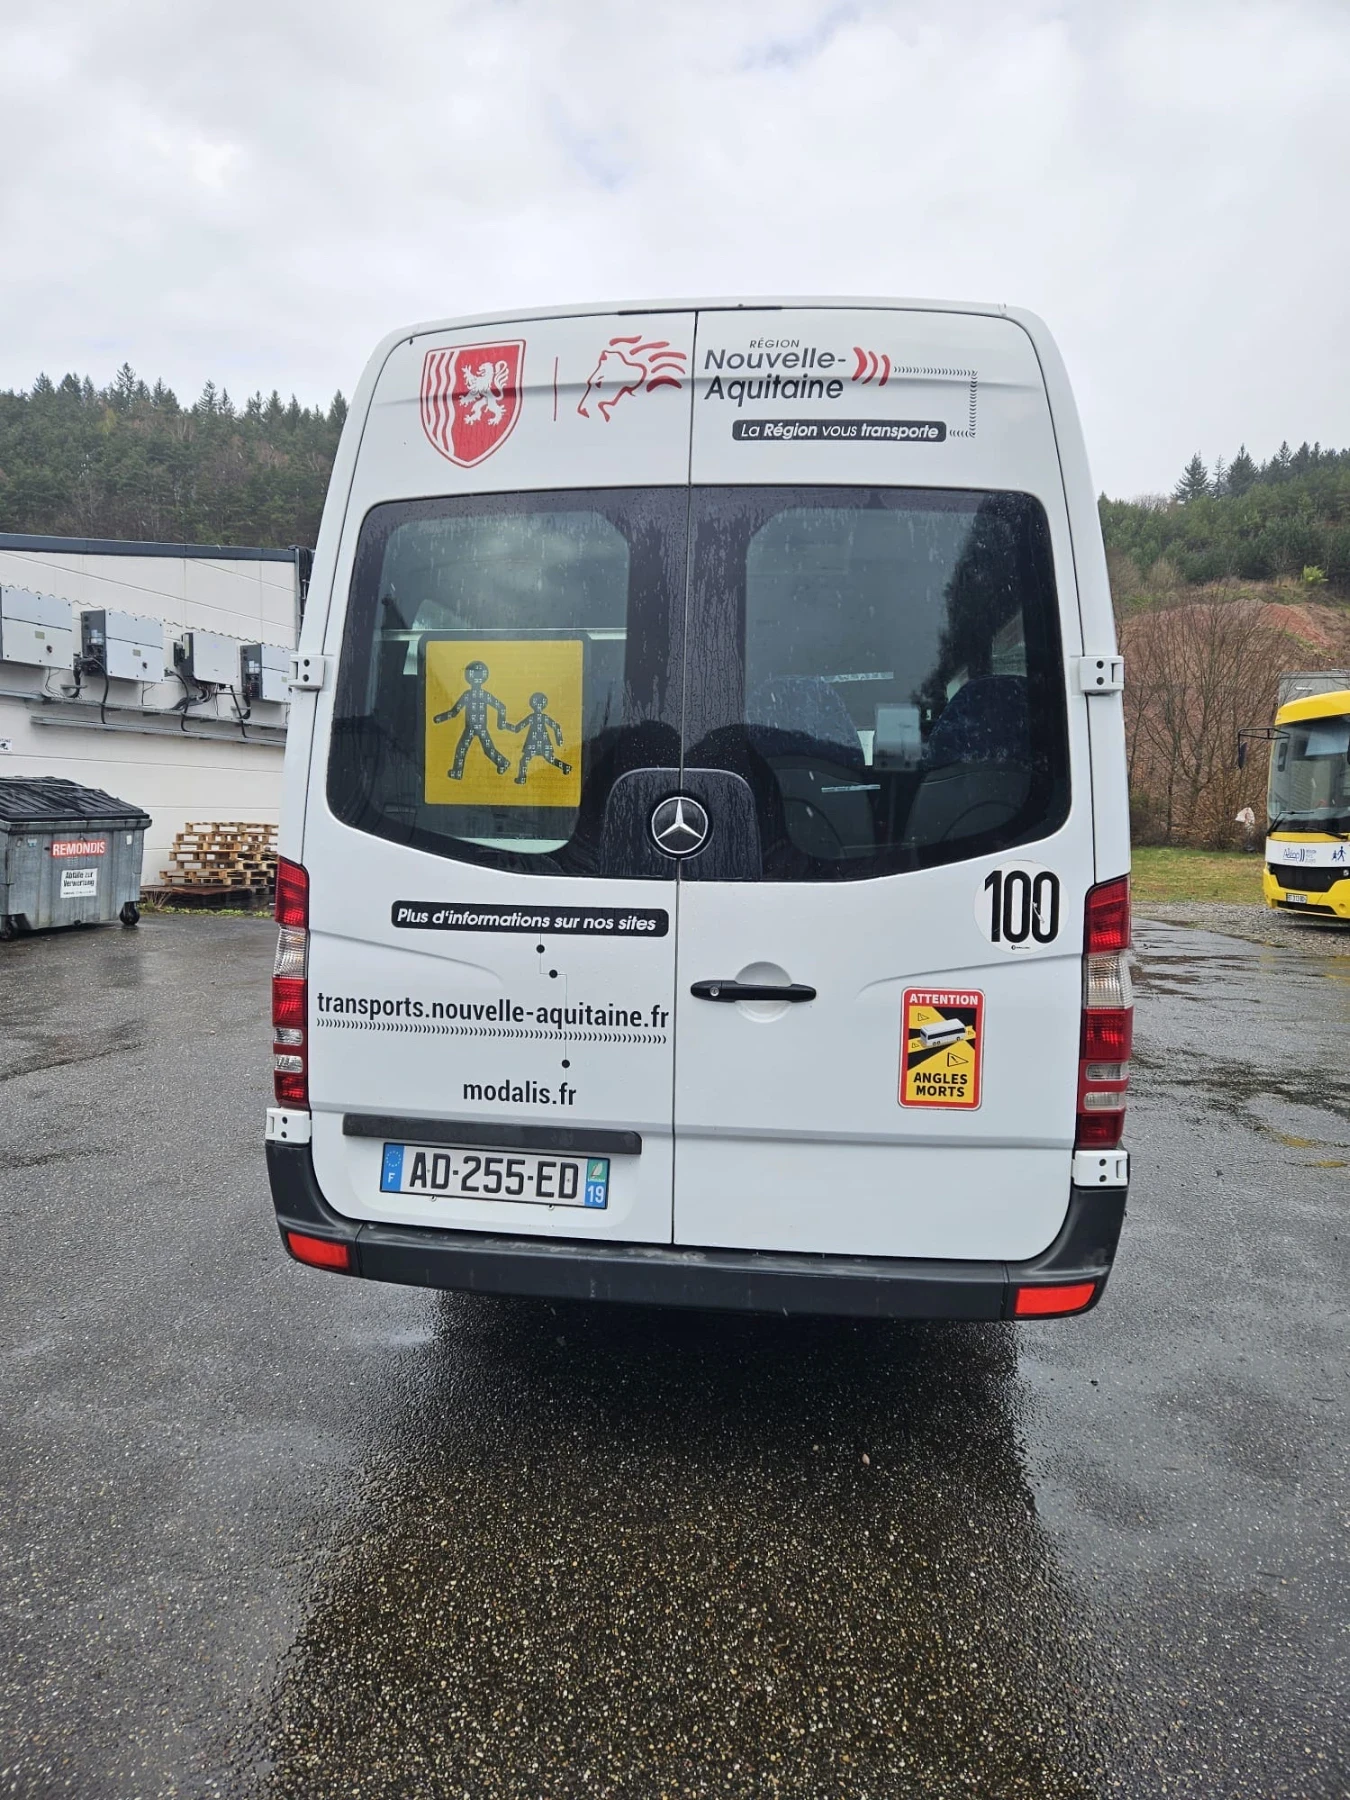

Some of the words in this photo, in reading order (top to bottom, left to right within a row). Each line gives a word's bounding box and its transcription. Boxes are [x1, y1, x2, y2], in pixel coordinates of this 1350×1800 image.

[749, 337, 801, 349] RÉGION
[704, 347, 847, 370] Nouvelle-
[704, 374, 844, 407] Aquitaine
[741, 423, 759, 437] La
[764, 422, 818, 440] Région
[823, 426, 858, 438] vous
[861, 424, 940, 441] transporte
[52, 841, 106, 856] REMONDIS
[984, 869, 1061, 944] 100
[396, 908, 429, 924] Plus
[432, 909, 551, 929] d'informations
[554, 914, 580, 929] sur
[583, 915, 614, 930] nos
[618, 915, 657, 931] sites
[909, 993, 979, 1006] ATTENTION
[317, 992, 670, 1031] transports.nouvelle-aquitaine.fr
[913, 1072, 968, 1085] ANGLES
[462, 1079, 578, 1106] modalis.fr
[915, 1085, 965, 1098] MORTS
[387, 1172, 396, 1183] F
[409, 1151, 579, 1199] AD-255-ED
[587, 1185, 605, 1204] 19
